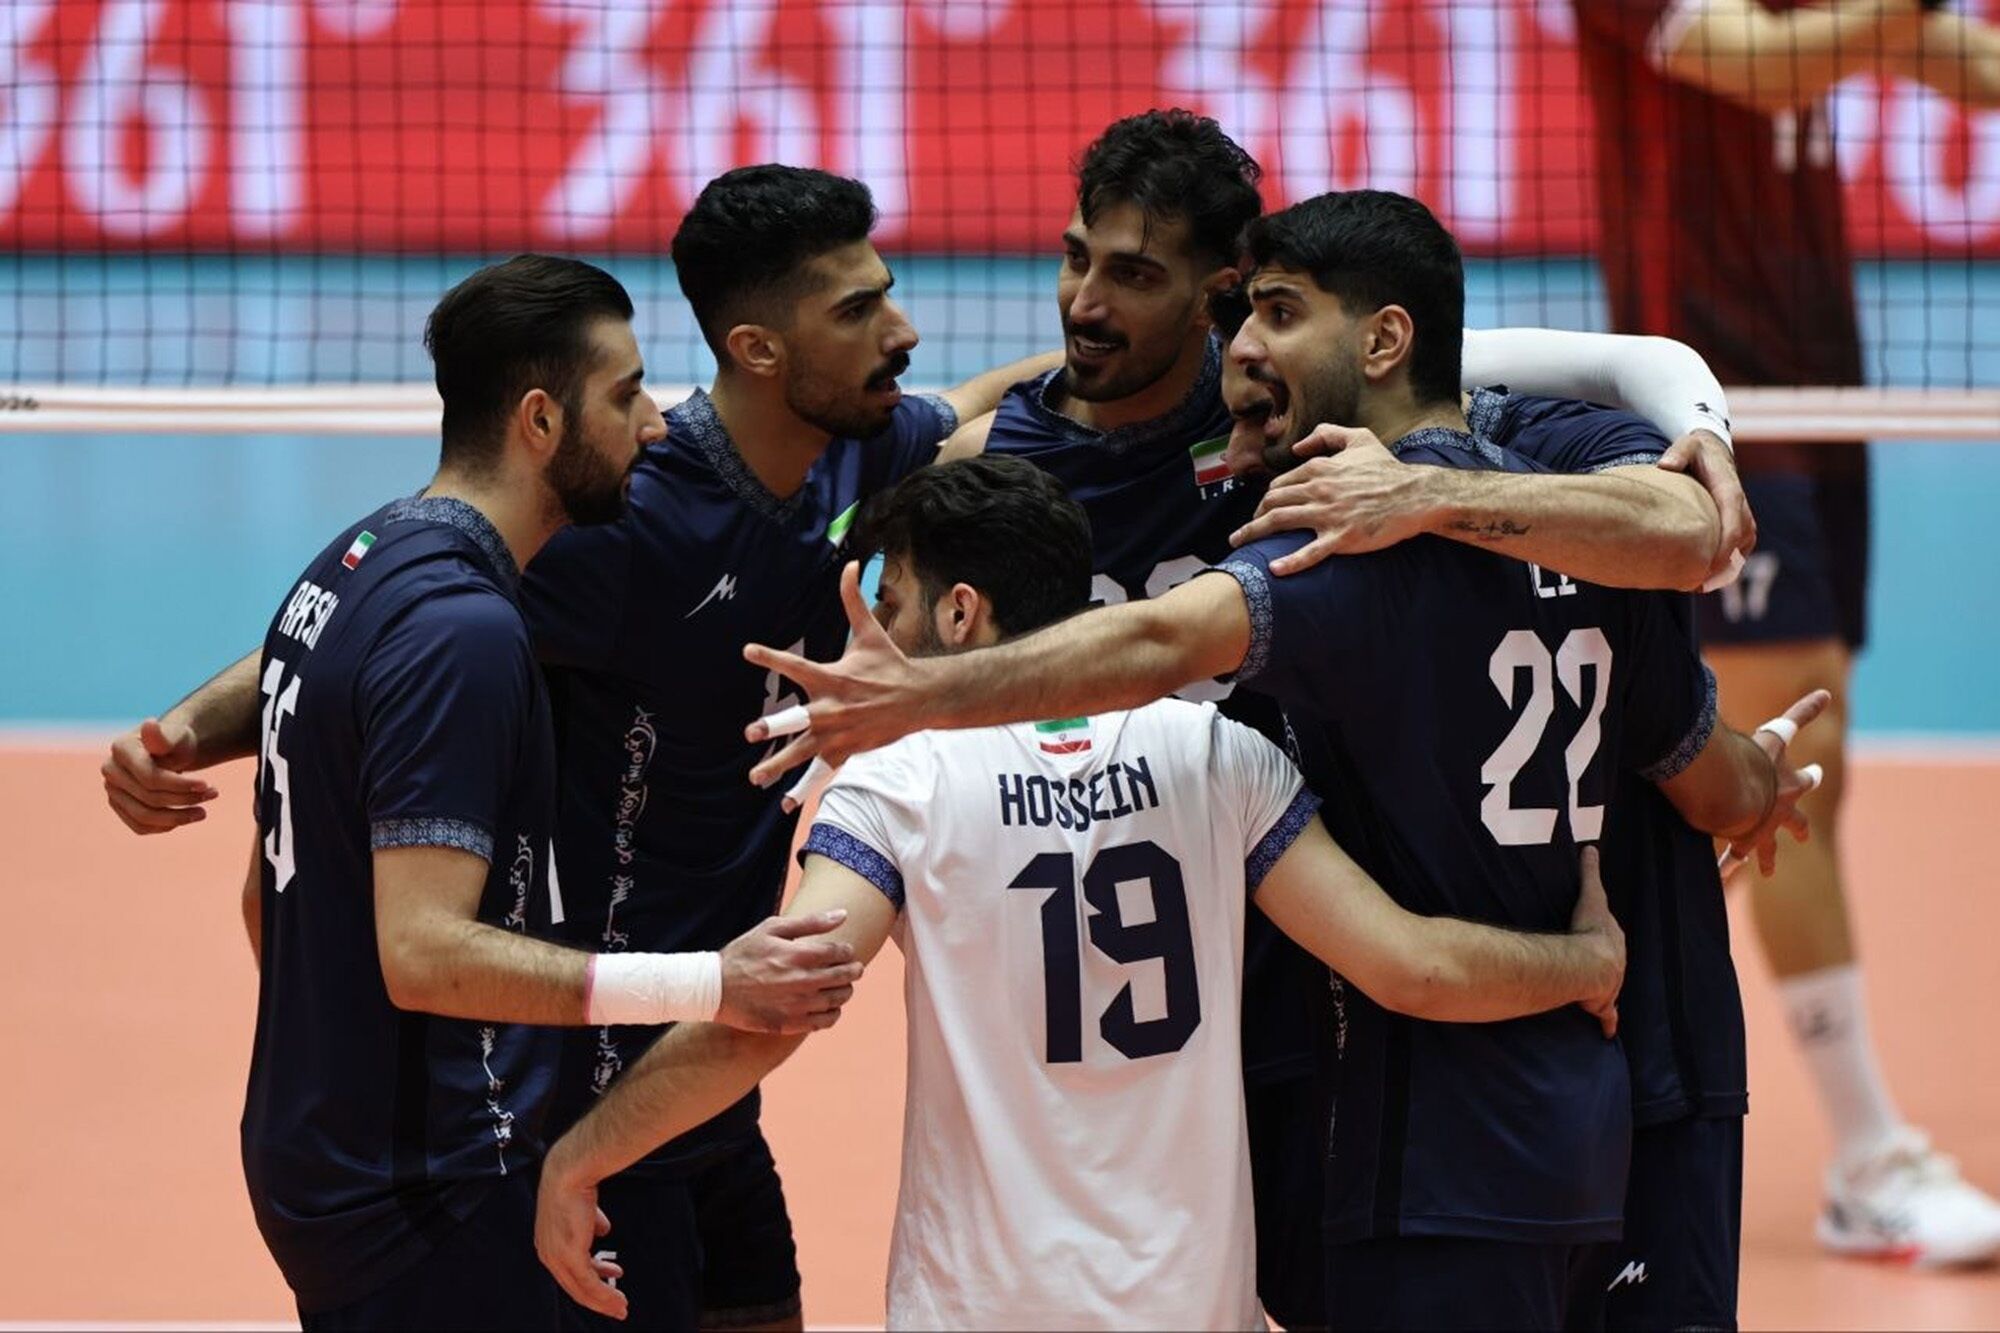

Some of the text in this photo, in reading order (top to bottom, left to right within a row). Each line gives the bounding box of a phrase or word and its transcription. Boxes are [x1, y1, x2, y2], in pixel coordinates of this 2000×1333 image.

[261, 657, 302, 893] 15
[998, 756, 1159, 832] HOSSEIN
[1480, 627, 1613, 846] 22
[1007, 840, 1201, 1064] 19
